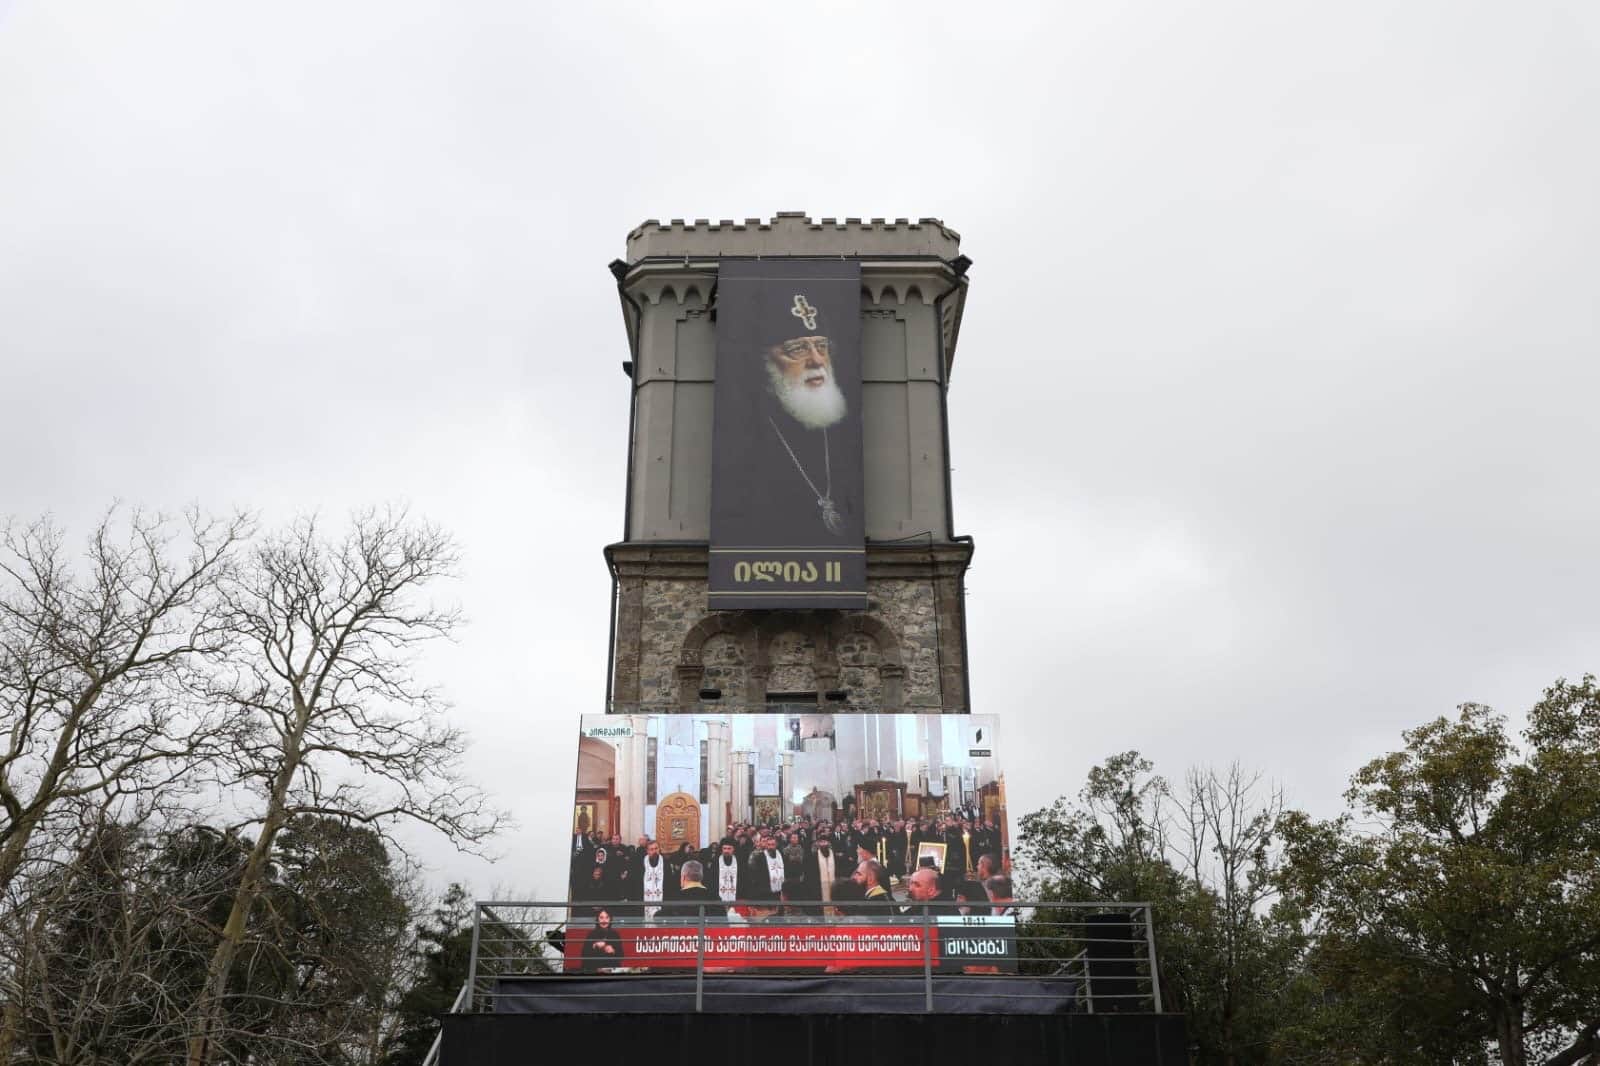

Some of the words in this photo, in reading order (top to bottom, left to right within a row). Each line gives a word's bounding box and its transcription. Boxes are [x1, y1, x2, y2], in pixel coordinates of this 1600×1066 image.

[734, 561, 818, 582] ილია
[635, 935, 714, 953] საქართველს
[716, 935, 786, 953] პატრიარქის
[789, 934, 855, 953] დაკრძალვის
[857, 934, 921, 952] ცერემონია
[947, 937, 1005, 955] მოამბე
